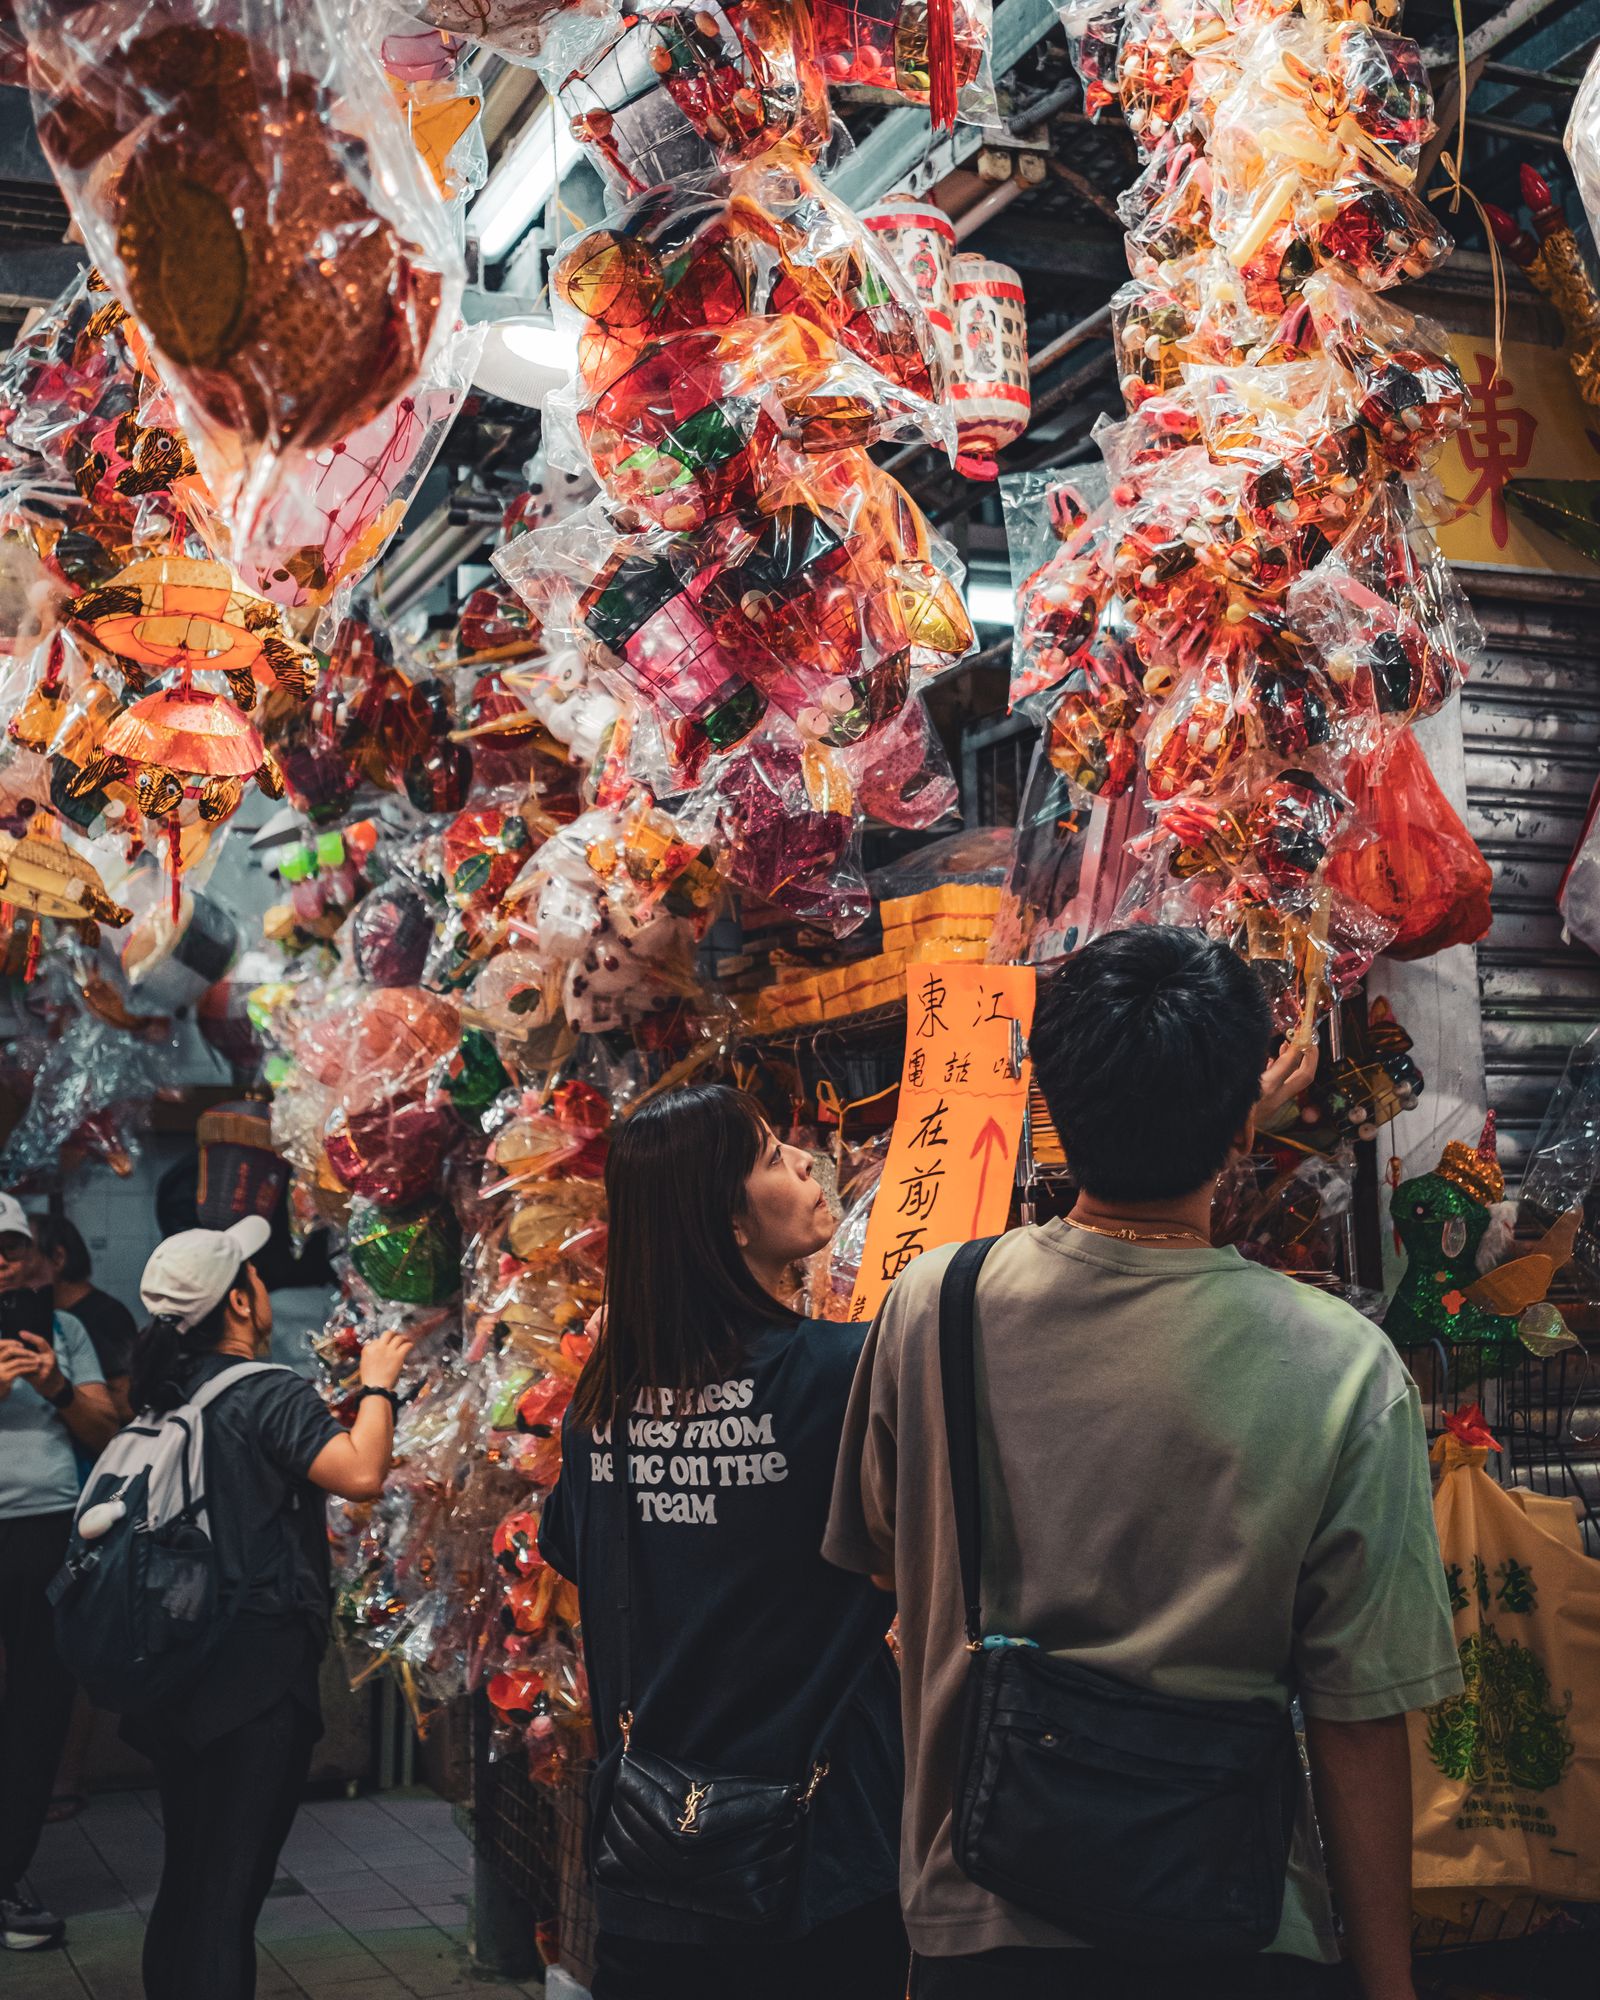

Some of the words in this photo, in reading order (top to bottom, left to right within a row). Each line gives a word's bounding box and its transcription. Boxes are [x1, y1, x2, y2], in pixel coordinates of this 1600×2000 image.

[1446, 352, 1538, 549] 東
[916, 972, 1014, 1038] 東江
[881, 1098, 949, 1280] 在前面
[682, 1413, 776, 1448] FROM
